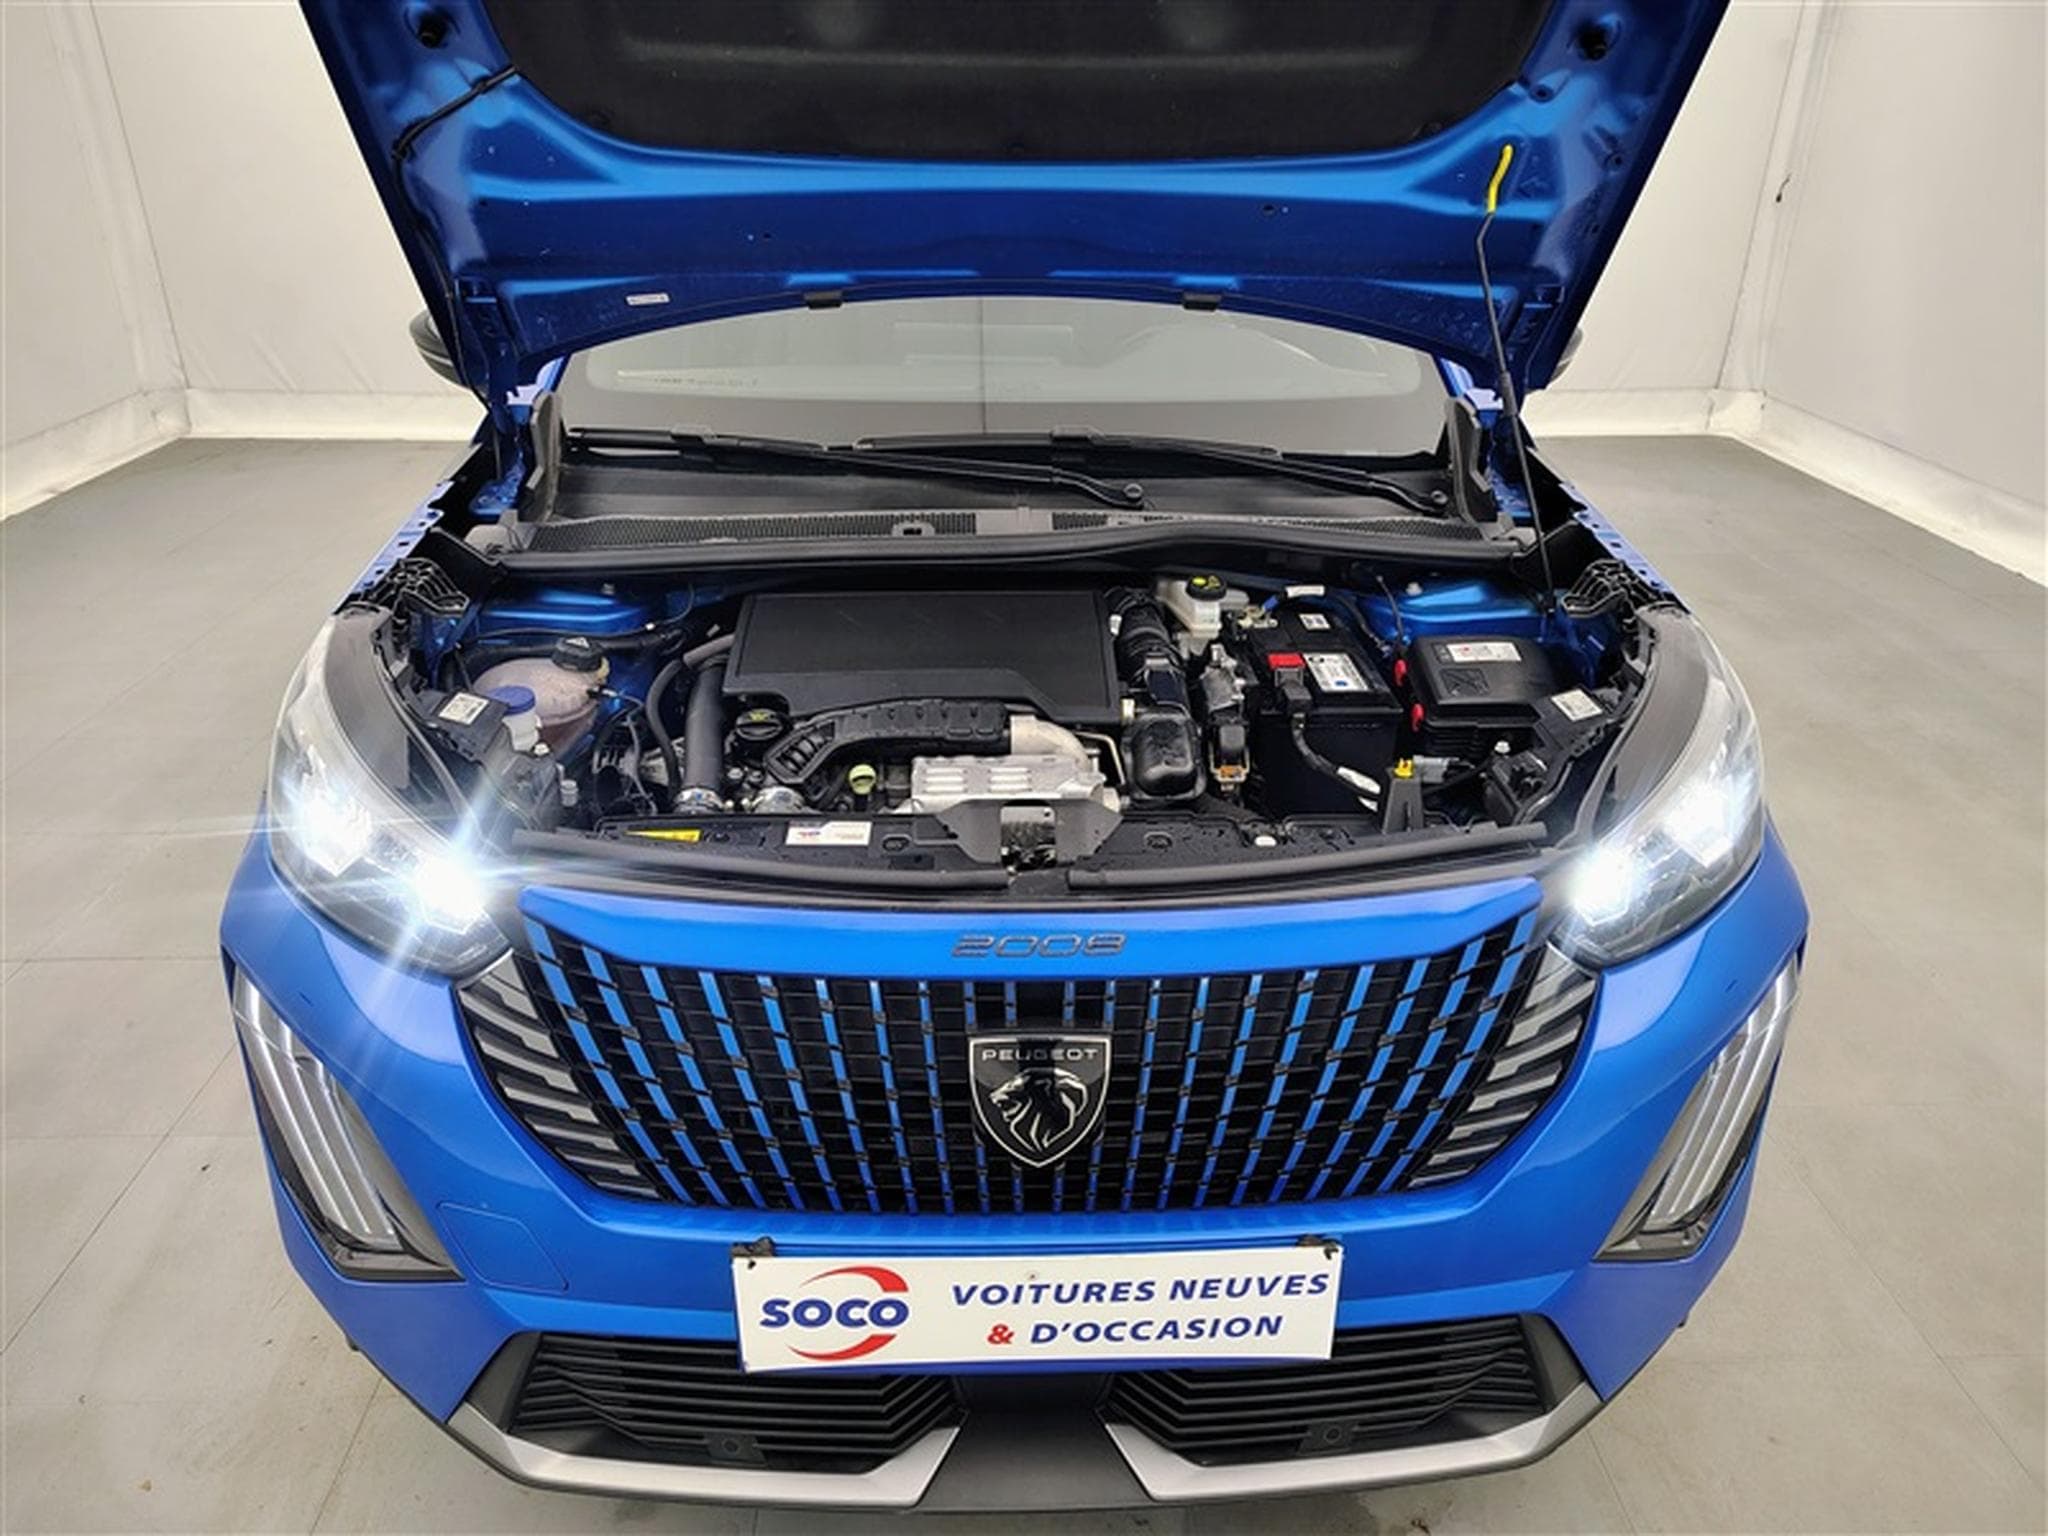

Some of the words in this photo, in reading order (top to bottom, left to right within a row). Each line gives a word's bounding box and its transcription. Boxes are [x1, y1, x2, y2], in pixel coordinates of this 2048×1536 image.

[952, 932, 1126, 958] 2008
[981, 1048, 1099, 1062] PEUGEOT
[952, 1280, 1156, 1306] VOITURES
[1169, 1273, 1330, 1301] NEUVES
[760, 1298, 910, 1329] SOCO
[987, 1323, 1015, 1345] &
[1030, 1315, 1283, 1344] D'OCCASION
